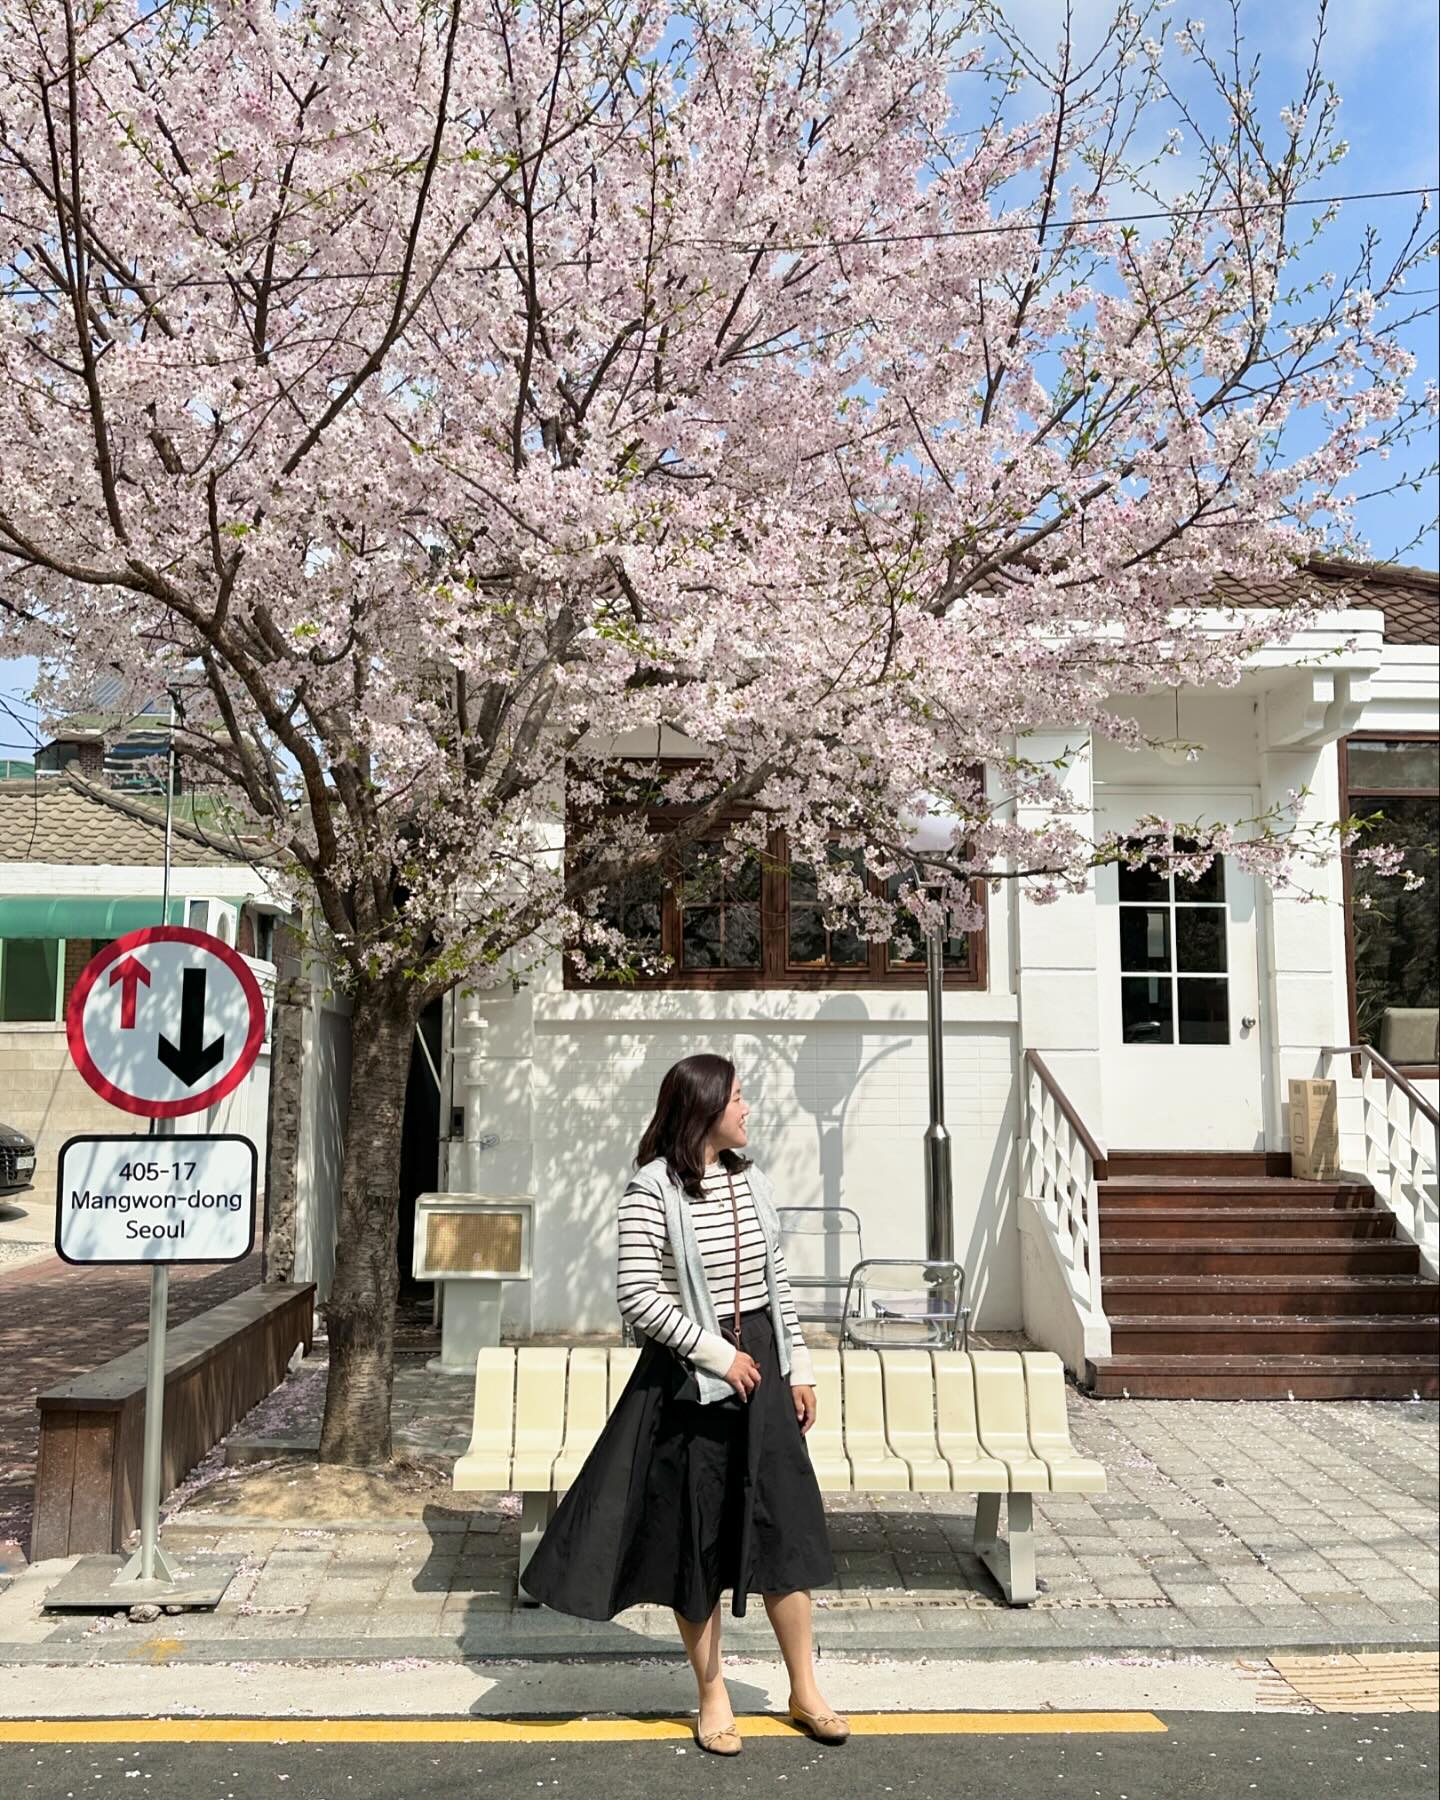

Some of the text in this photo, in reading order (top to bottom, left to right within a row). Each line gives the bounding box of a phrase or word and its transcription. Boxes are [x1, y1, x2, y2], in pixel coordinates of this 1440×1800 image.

[119, 1162, 196, 1181] 405-17
[71, 1190, 242, 1213] Mangwon-dong
[126, 1220, 185, 1239] Seoul
